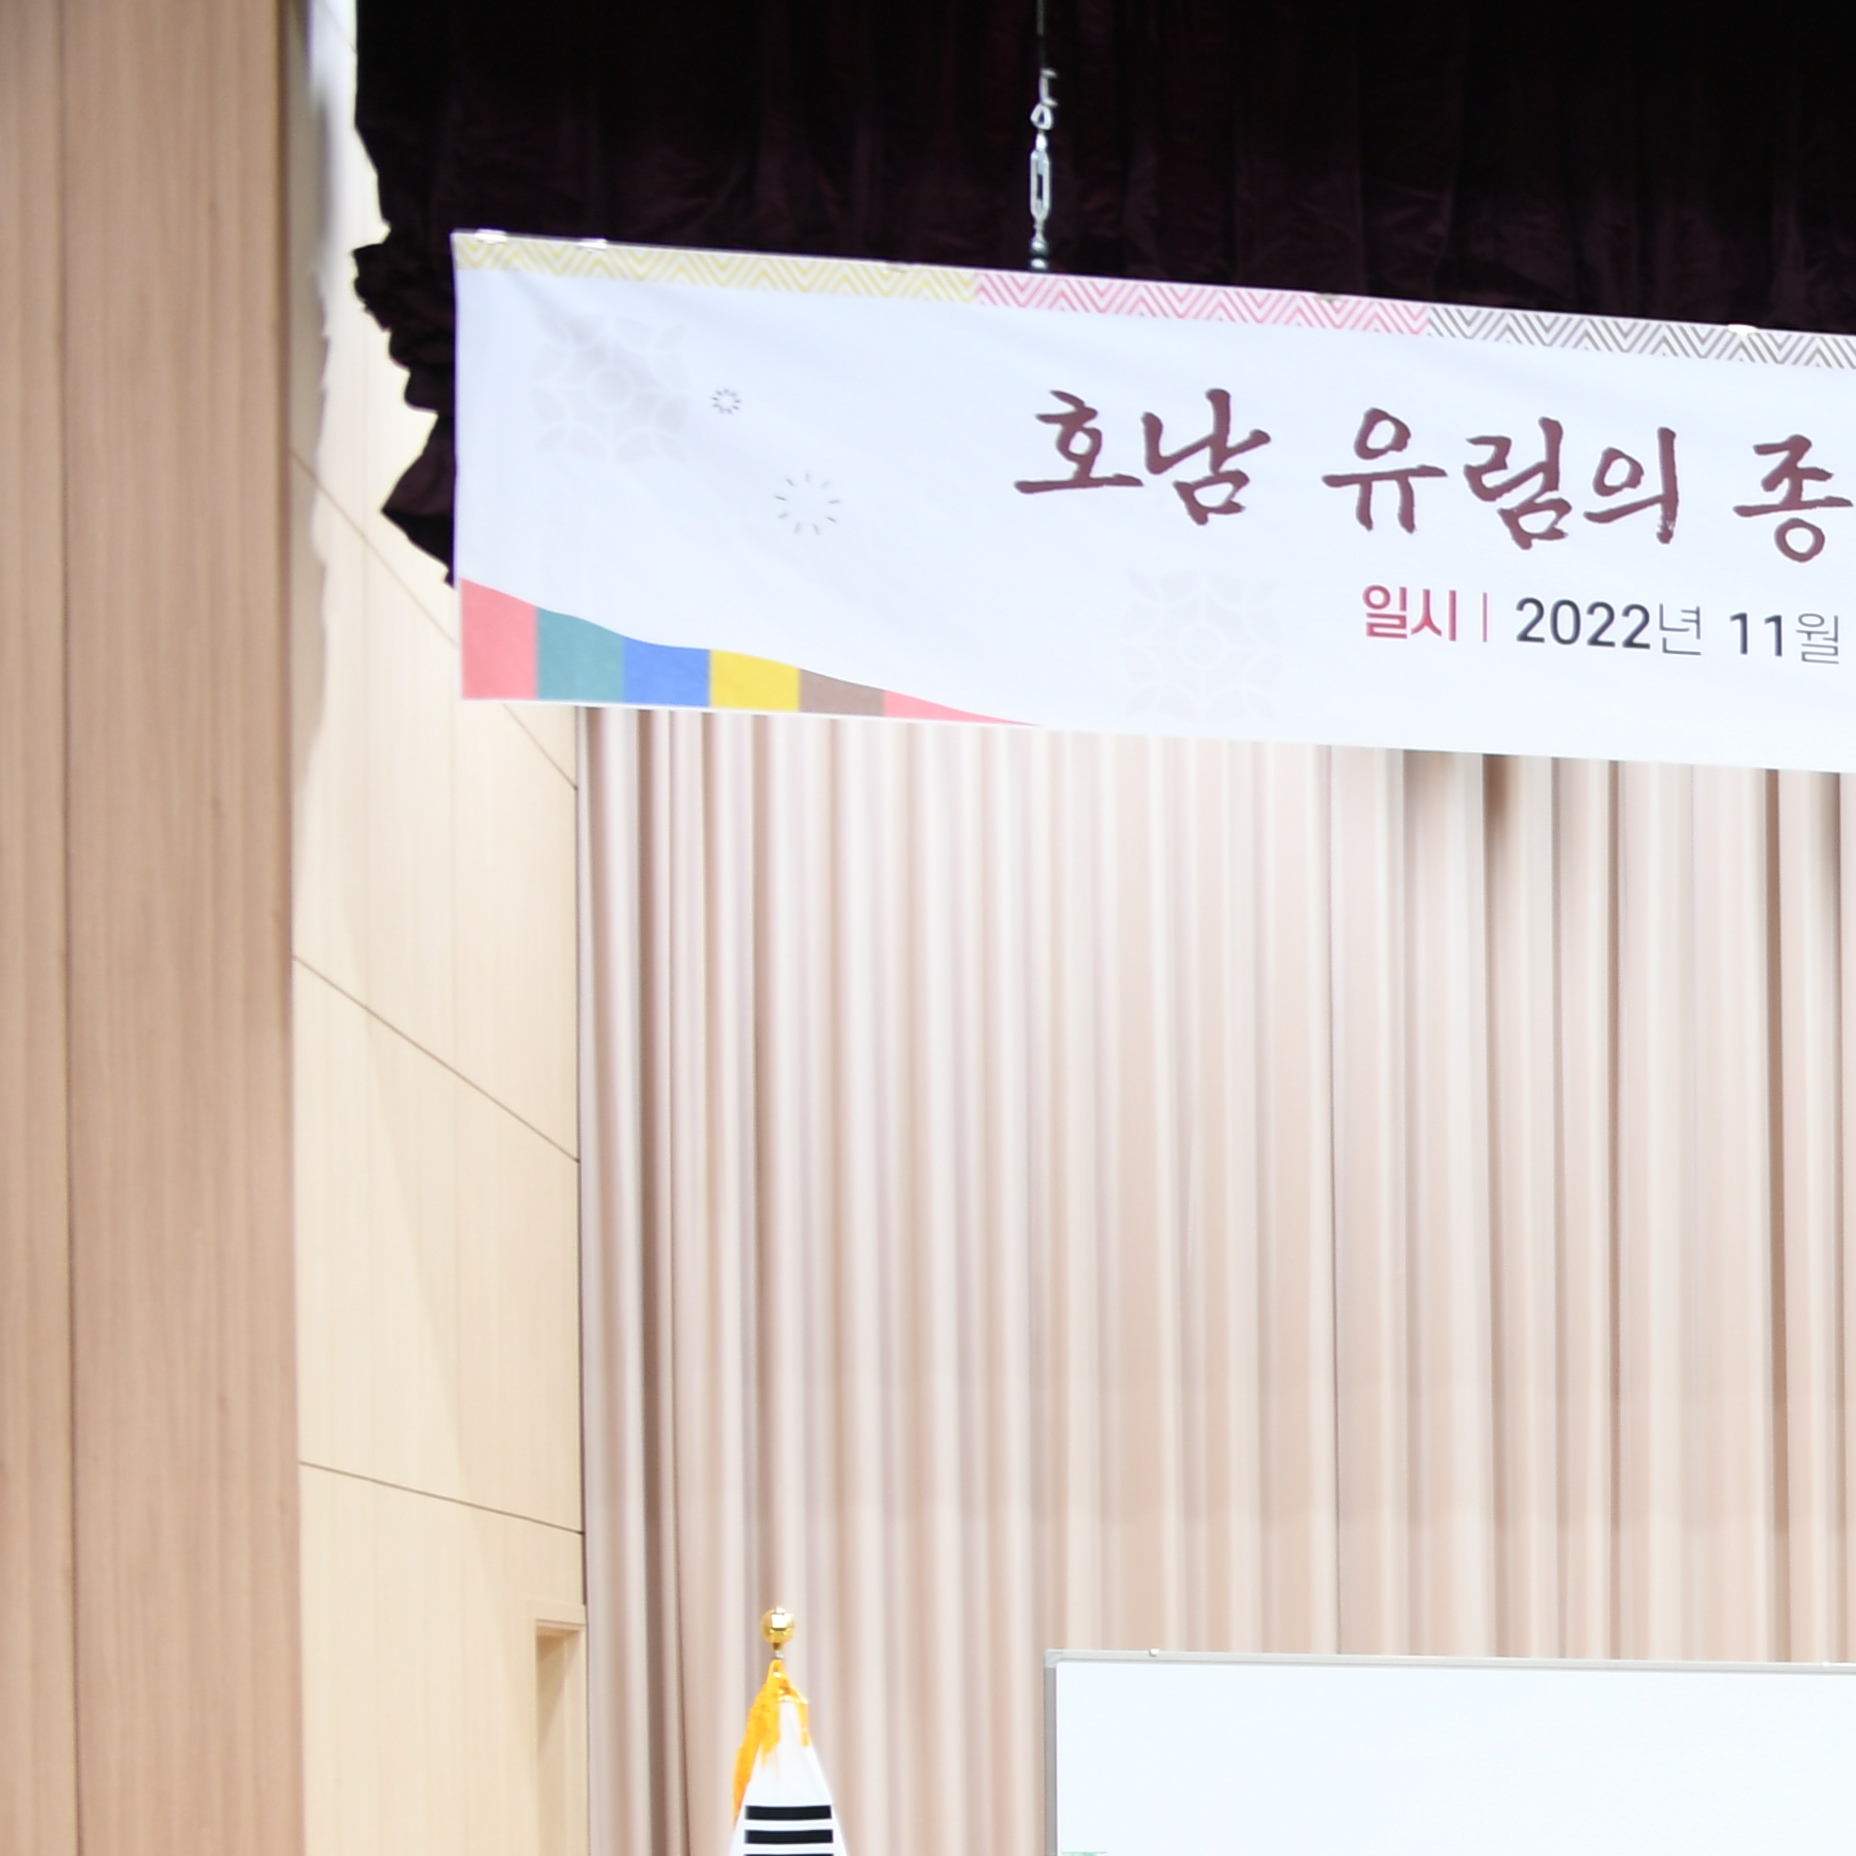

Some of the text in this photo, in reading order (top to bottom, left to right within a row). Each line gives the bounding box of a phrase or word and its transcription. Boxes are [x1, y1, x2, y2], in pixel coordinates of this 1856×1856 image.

[1014, 388, 1272, 526] 호남
[1321, 407, 1680, 551] 유림의
[1362, 584, 1457, 642] 일시
[1516, 597, 1701, 656] 2022년
[1729, 612, 1839, 664] 11월
